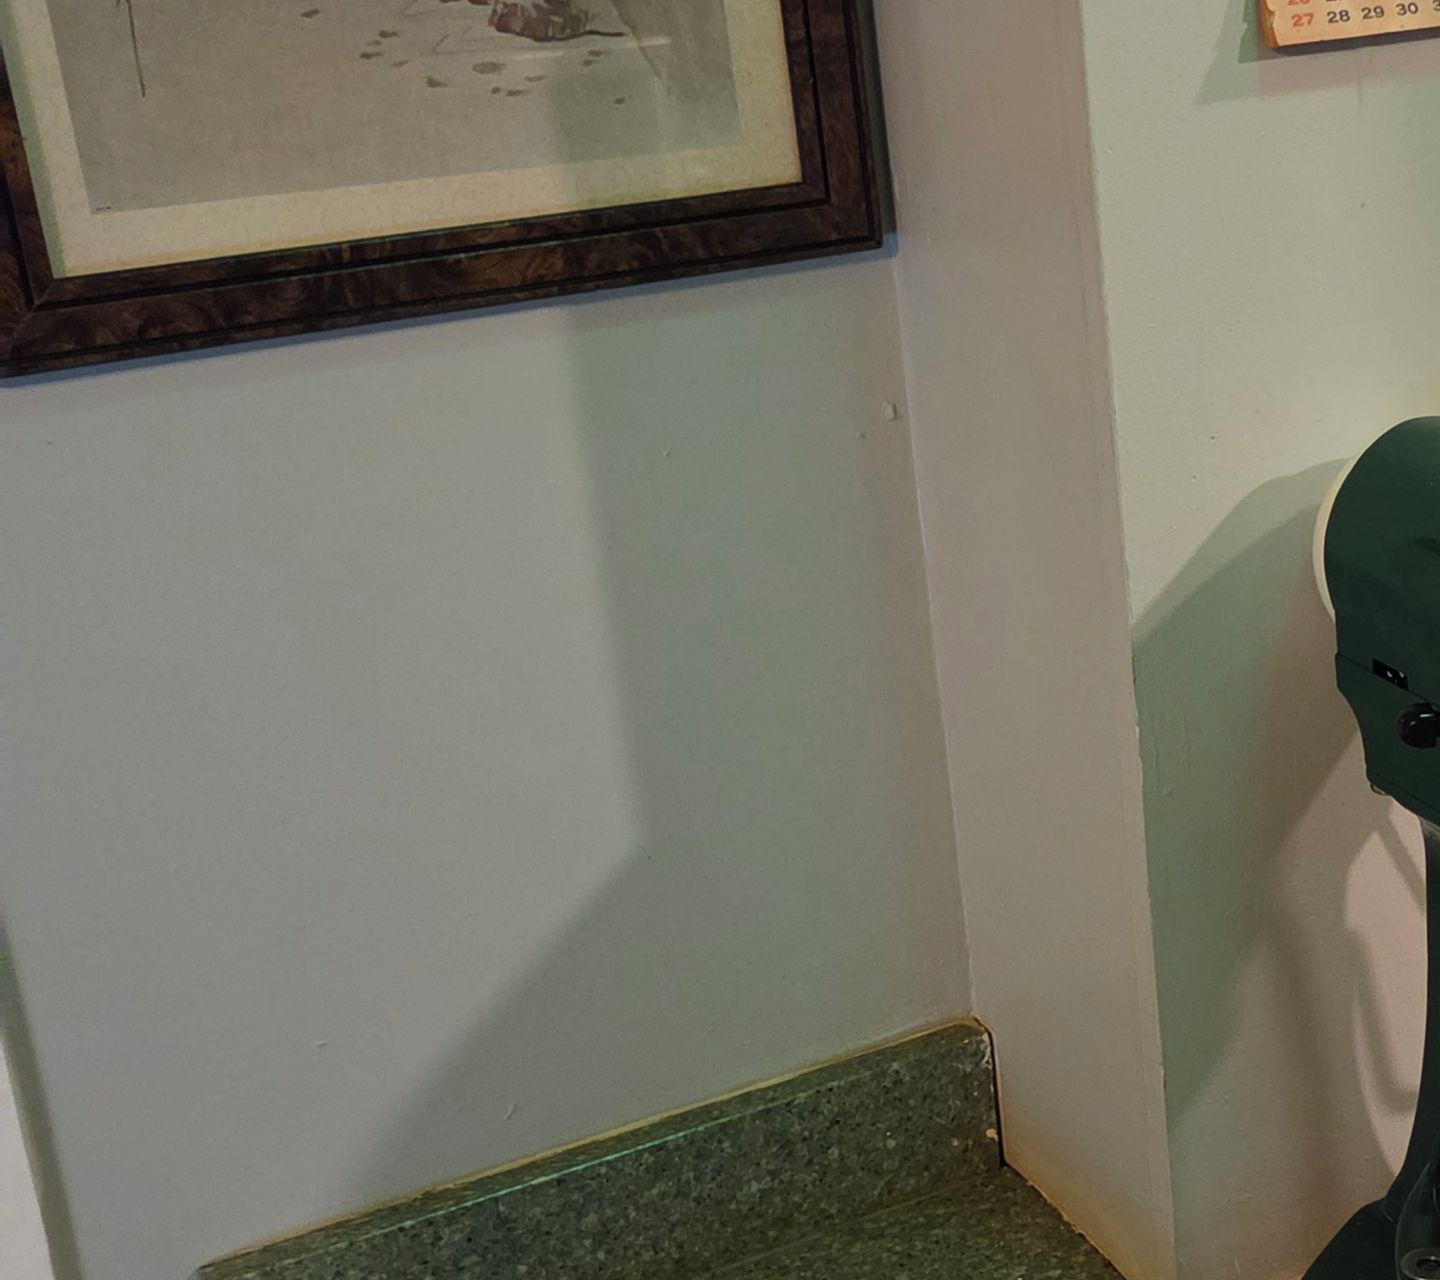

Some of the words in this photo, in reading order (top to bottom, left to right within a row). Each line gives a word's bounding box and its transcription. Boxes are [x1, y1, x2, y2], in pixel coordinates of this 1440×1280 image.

[1290, 12, 1314, 28] 27
[1326, 9, 1351, 24] 28
[1361, 5, 1385, 20] 29
[1395, 2, 1419, 16] 30
